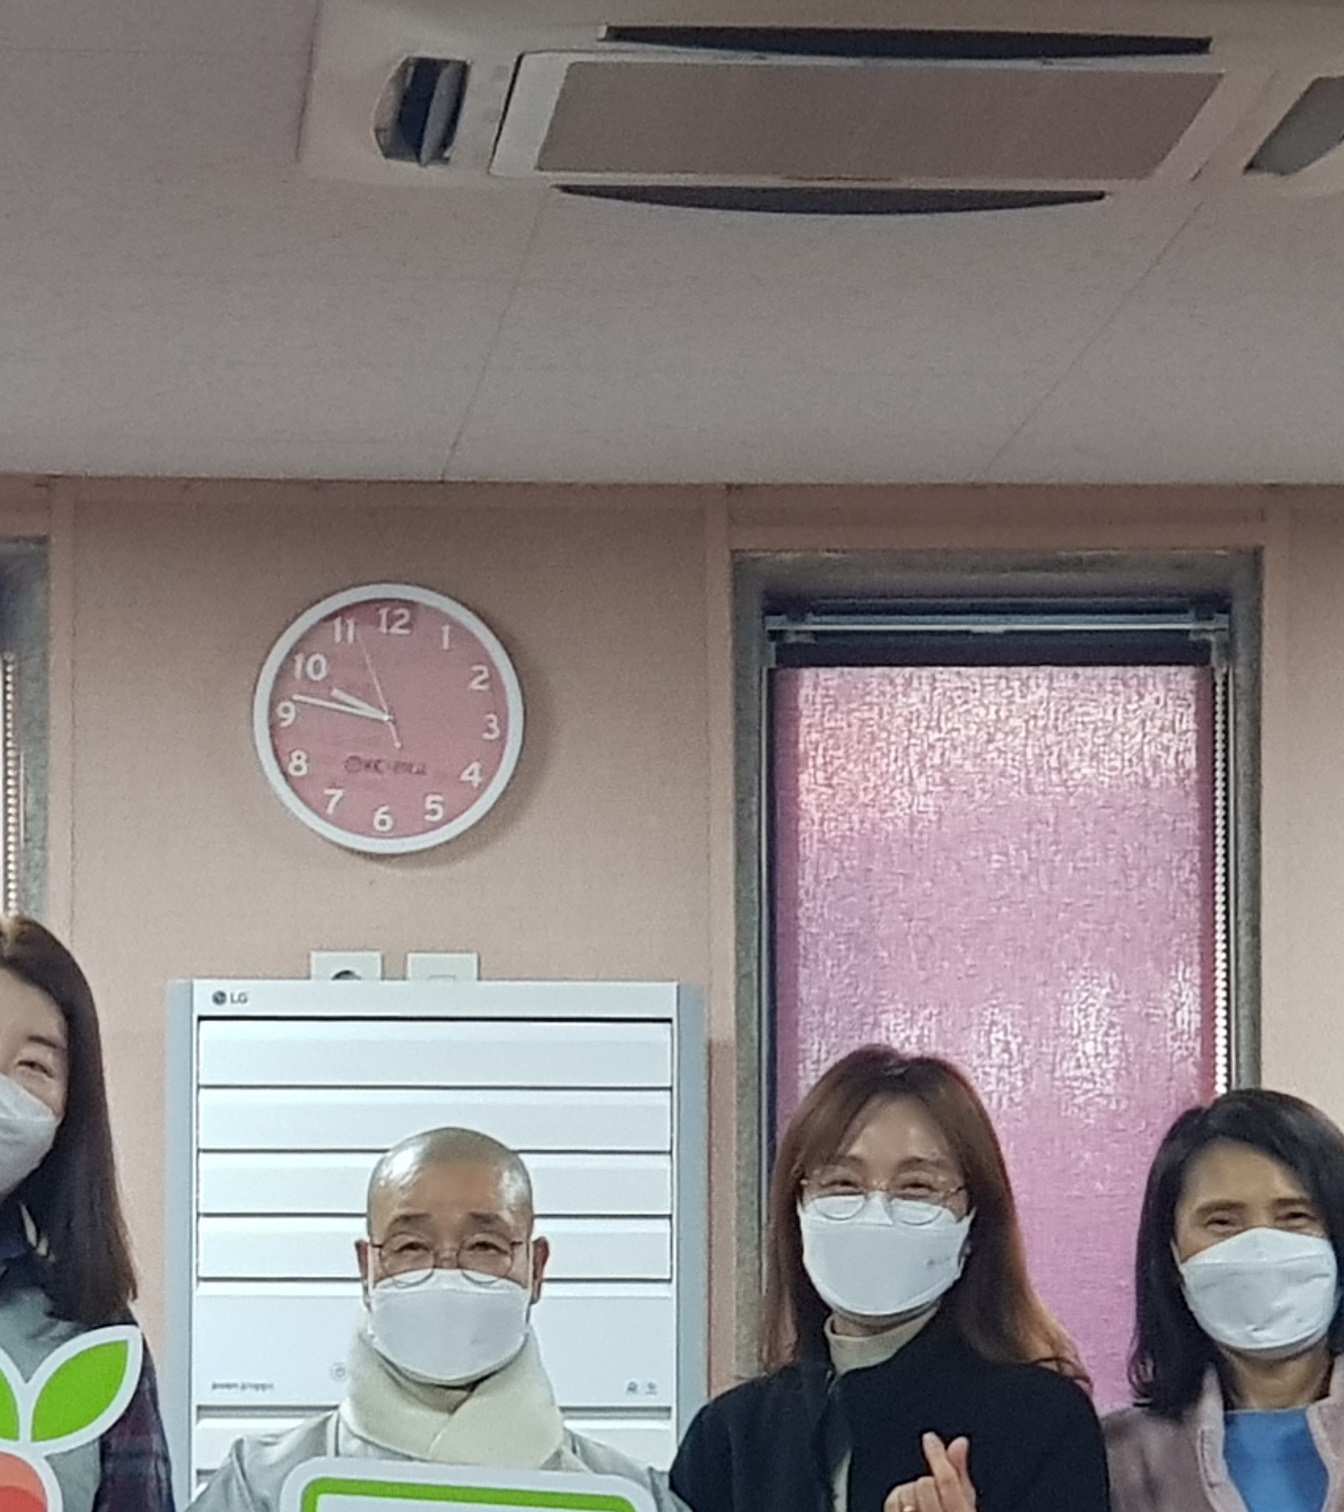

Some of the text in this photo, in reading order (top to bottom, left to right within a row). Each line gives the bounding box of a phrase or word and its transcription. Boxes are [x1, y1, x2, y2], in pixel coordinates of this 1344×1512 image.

[333, 616, 355, 643] 11
[378, 607, 411, 635] 12
[441, 624, 451, 650] 1
[294, 653, 328, 681] 10
[469, 665, 490, 691] 2
[276, 700, 296, 727] 9
[482, 714, 500, 740] 3
[288, 750, 307, 776] 8
[460, 761, 482, 788] 4
[324, 788, 346, 815] 7
[424, 795, 444, 822] 5
[373, 805, 393, 832] 6
[230, 991, 248, 1004] LG
